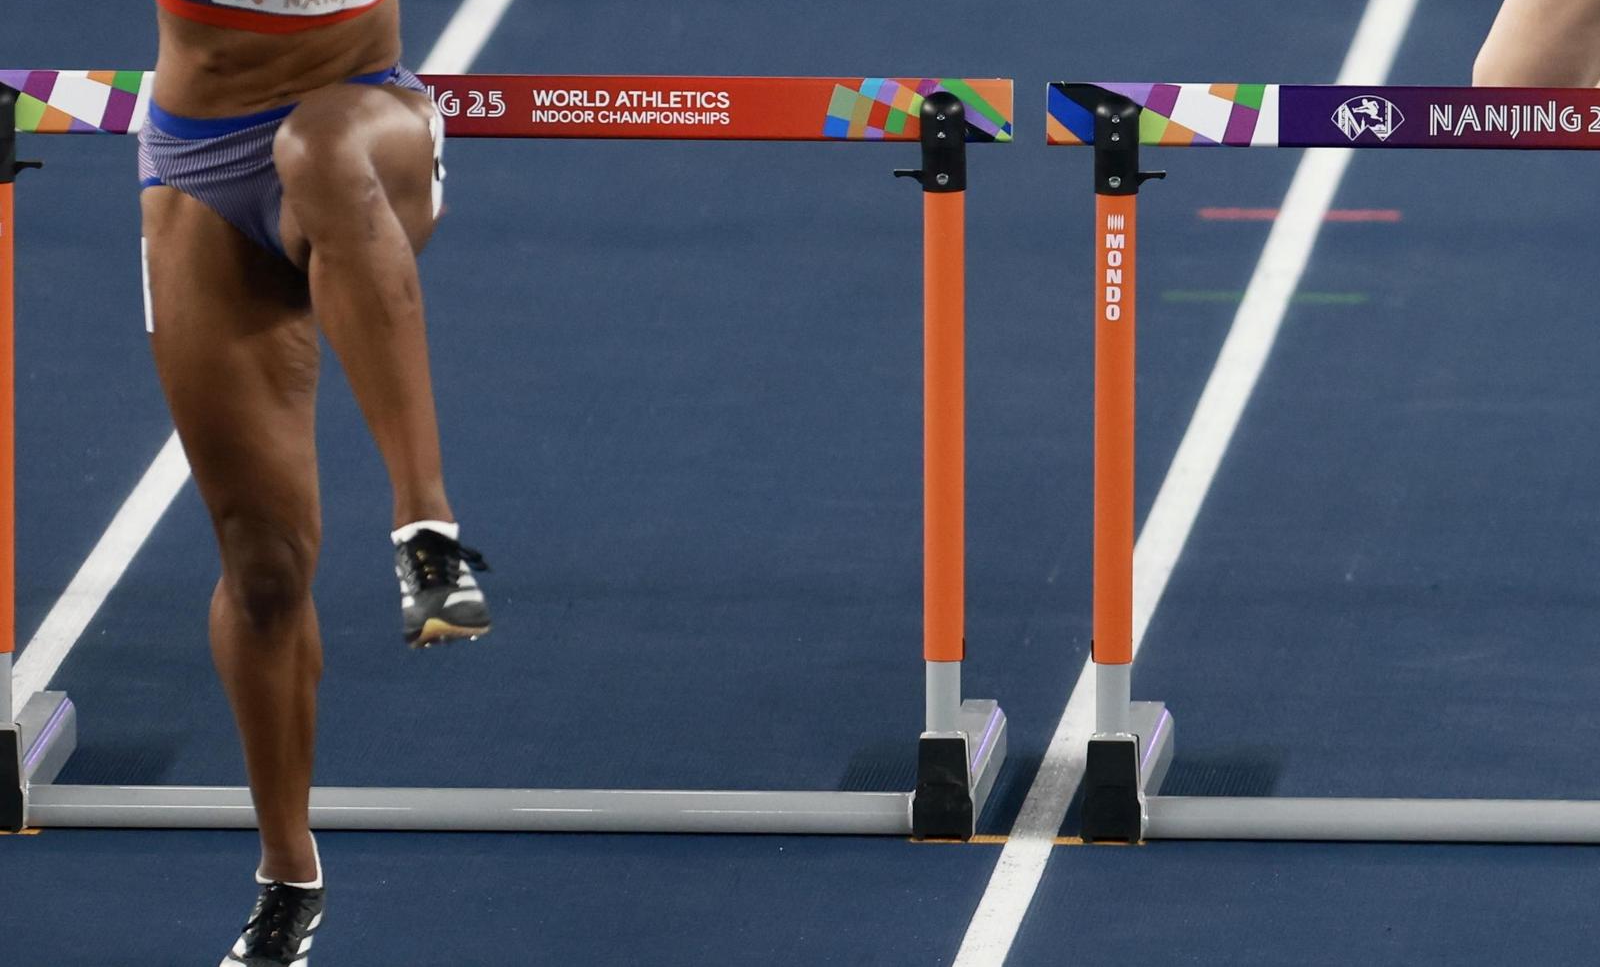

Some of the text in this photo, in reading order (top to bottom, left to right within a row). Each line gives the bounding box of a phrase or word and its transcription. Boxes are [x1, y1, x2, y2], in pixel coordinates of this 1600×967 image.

[466, 90, 506, 118] 25
[532, 89, 730, 109] WORLD ATHLETICS
[532, 110, 730, 125] INDOOR CHAMPIONSHIPS
[1429, 100, 1582, 139] NANJING
[1105, 233, 1125, 321] MONDO
